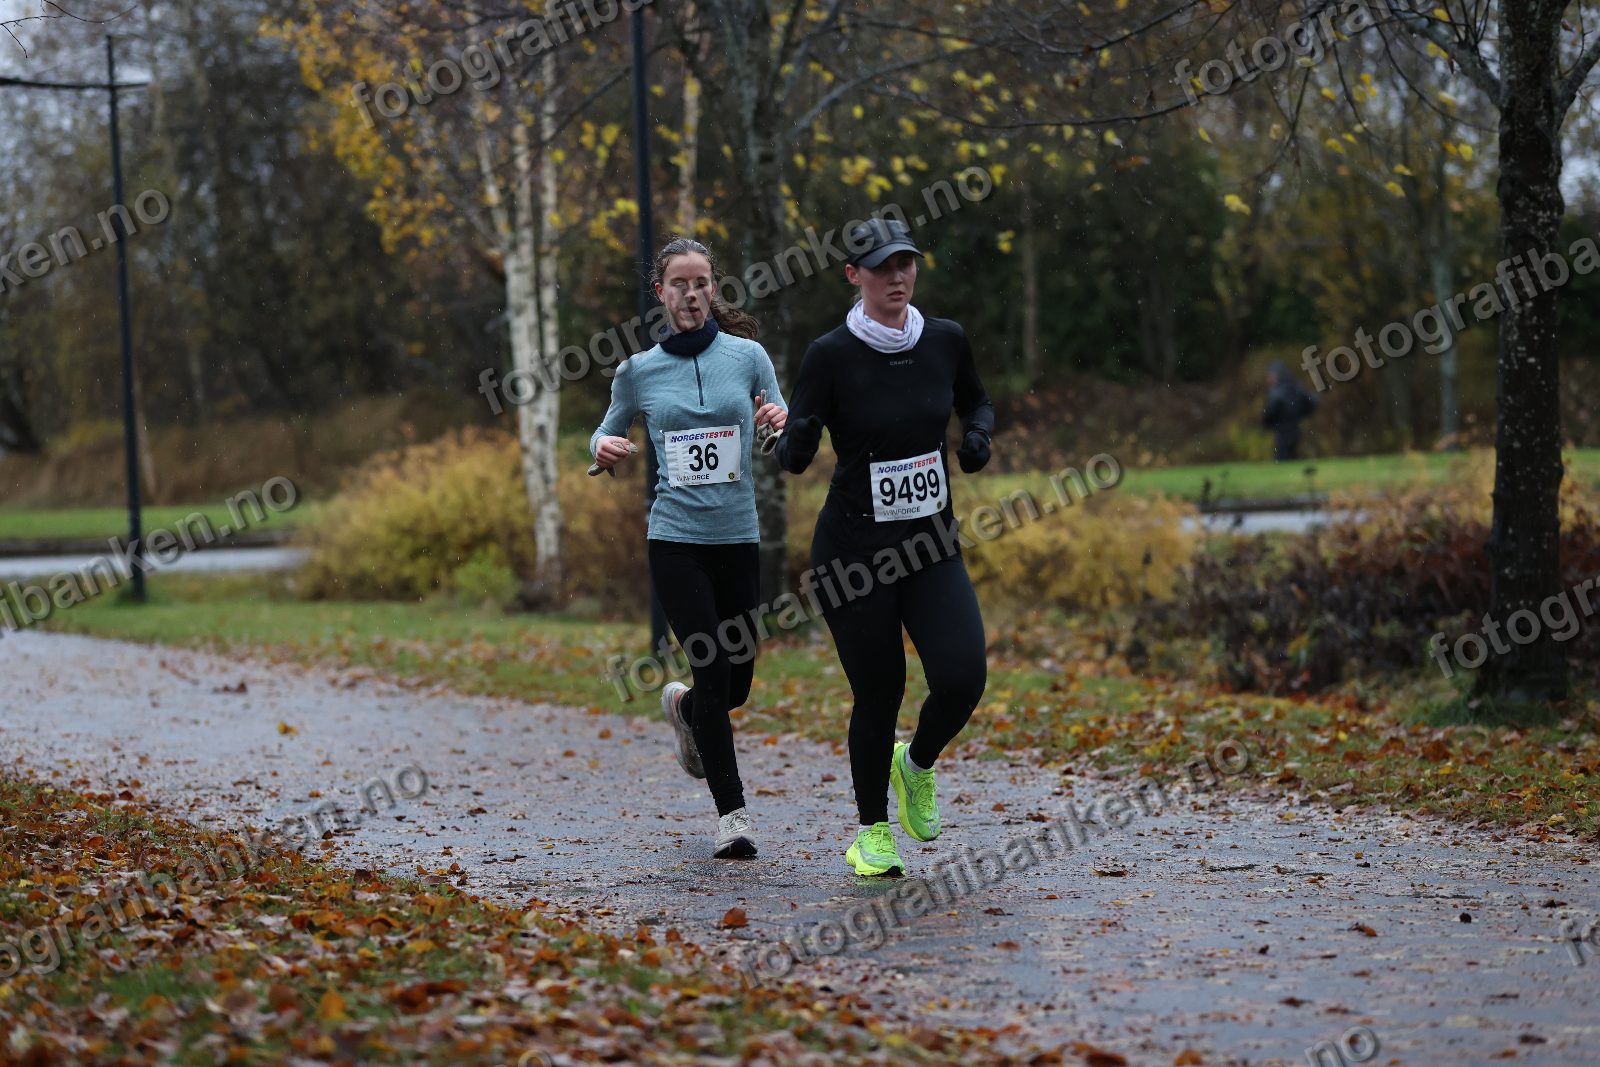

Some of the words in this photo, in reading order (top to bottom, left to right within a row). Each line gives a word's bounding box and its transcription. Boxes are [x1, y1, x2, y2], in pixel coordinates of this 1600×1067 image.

[671, 430, 734, 442] NORGESTESTEN
[688, 443, 719, 472] 36
[877, 455, 938, 474] NORGESTESTEN
[879, 468, 940, 507] 9499
[882, 505, 921, 516] WINFORCE
